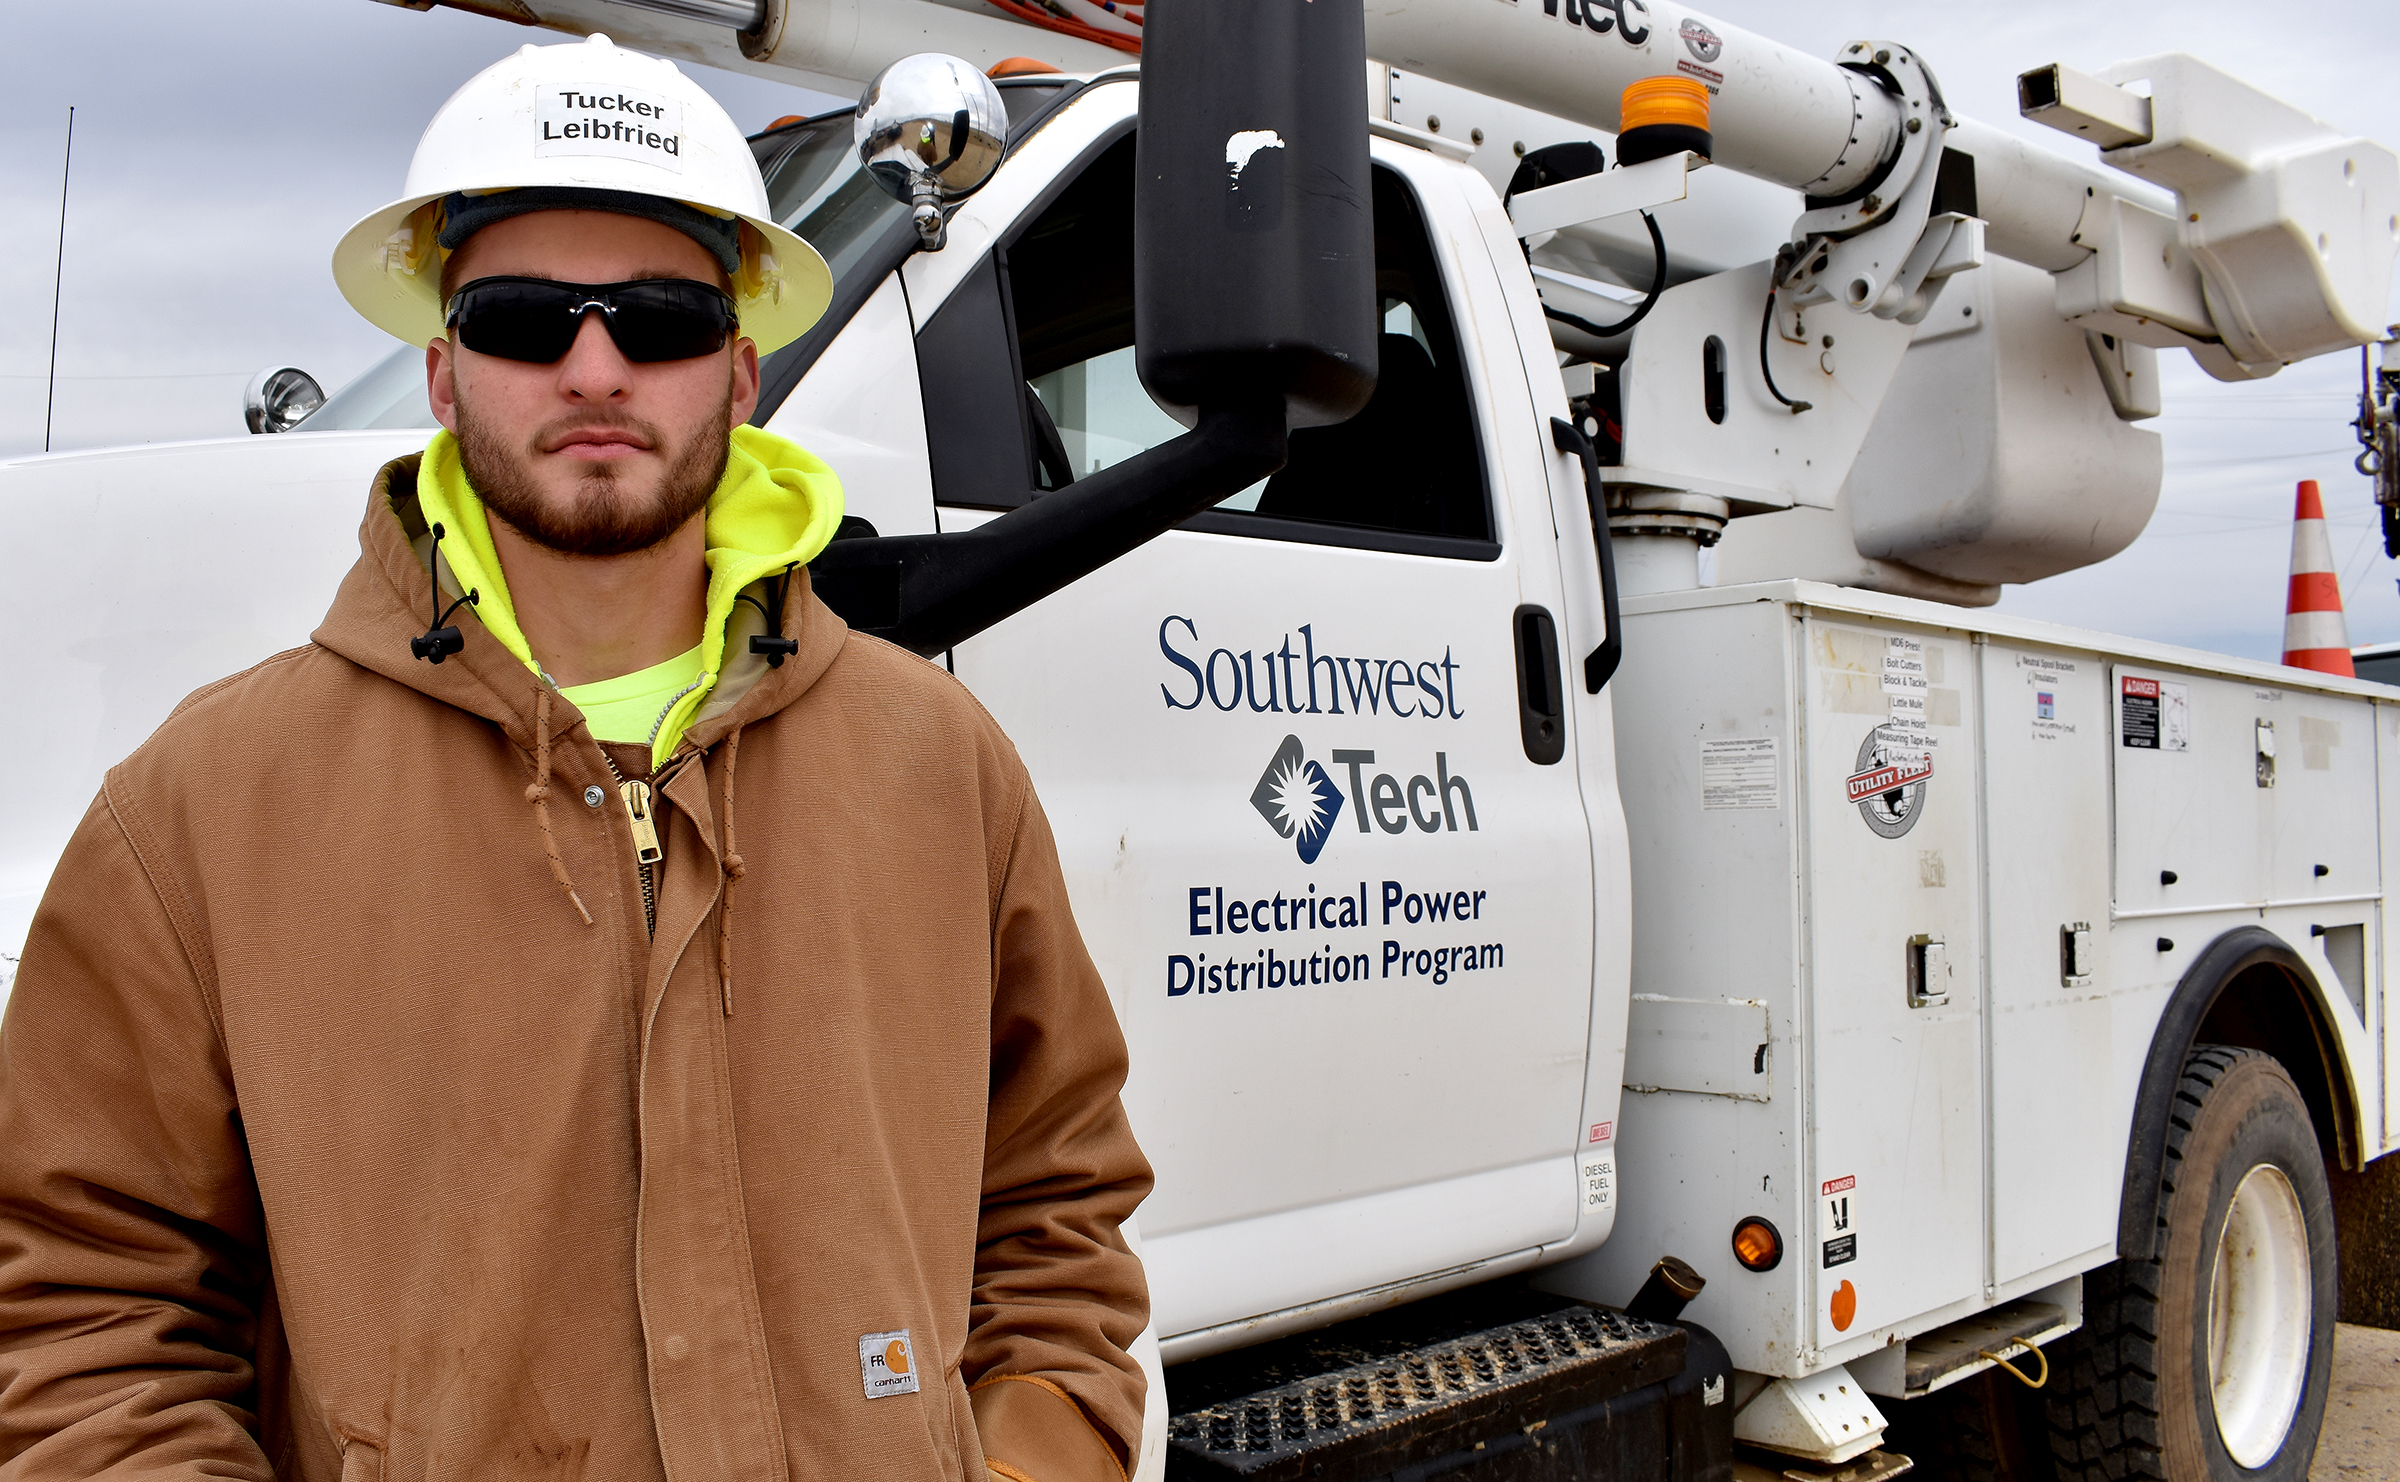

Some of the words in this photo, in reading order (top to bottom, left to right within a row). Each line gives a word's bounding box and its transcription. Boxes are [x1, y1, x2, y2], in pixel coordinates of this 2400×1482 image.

[559, 91, 664, 120] Tucker
[543, 118, 679, 157] Leibfried
[1158, 614, 1465, 720] Southwest
[1886, 657, 1899, 668] Bolt
[1900, 660, 1922, 671] Cutters
[1884, 674, 1901, 685] Block
[1909, 677, 1928, 688] Tackle
[2132, 680, 2157, 695] DANGER
[1892, 697, 1908, 708] Little
[1909, 699, 1923, 709] Mule
[1891, 716, 1909, 727] Chain
[1911, 718, 1927, 729] Hoist
[1877, 730, 1908, 746] Measuring
[1910, 735, 1924, 746] Tape
[1925, 736, 1938, 747] Reel
[1849, 770, 1895, 796] UTILITY
[1332, 748, 1479, 835] Tech
[1189, 882, 1368, 936] Electrical
[1382, 880, 1487, 925] Power
[1167, 944, 1369, 997] Distribution
[1382, 940, 1504, 986] Program
[1592, 1126, 1608, 1139] DIESEL
[1585, 1163, 1612, 1177] DIESEL
[1589, 1178, 1609, 1190] FUEL
[1831, 1177, 1854, 1193] DANGER
[1588, 1192, 1608, 1206] ONLY
[870, 1354, 886, 1368] FR
[874, 1375, 911, 1388] carhartt
